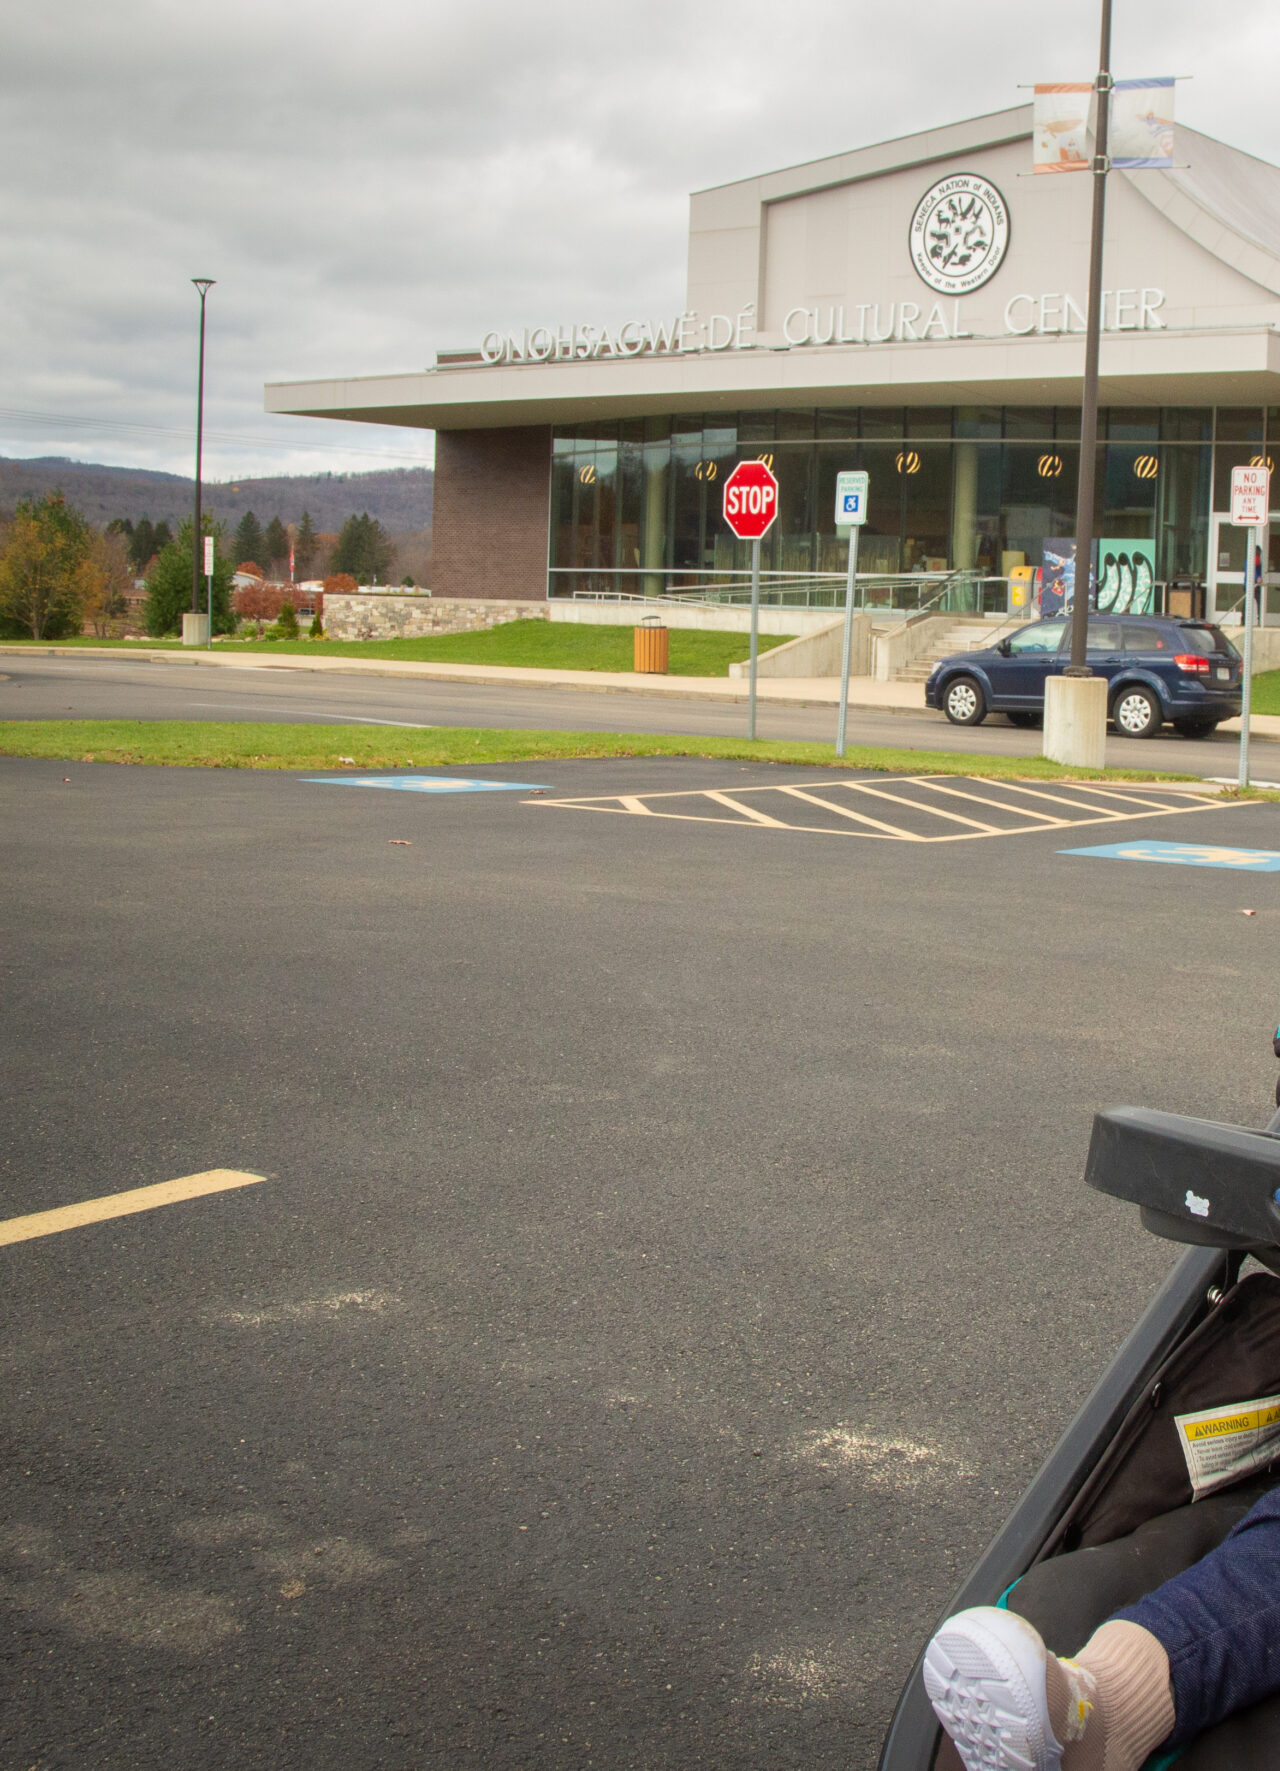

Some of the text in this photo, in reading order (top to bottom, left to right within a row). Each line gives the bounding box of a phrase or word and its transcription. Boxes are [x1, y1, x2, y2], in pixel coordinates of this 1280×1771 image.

[914, 195, 937, 233] SENECA
[938, 179, 970, 196] NATION
[983, 188, 1004, 226] INDIANS
[783, 298, 971, 346] CULTURAL
[1004, 287, 1167, 335] CENTER
[1243, 472, 1257, 484] NO
[727, 485, 774, 515] STOP
[1234, 485, 1265, 496] PARKING
[1241, 505, 1257, 513] TIME
[1202, 1416, 1250, 1436] WARNING
